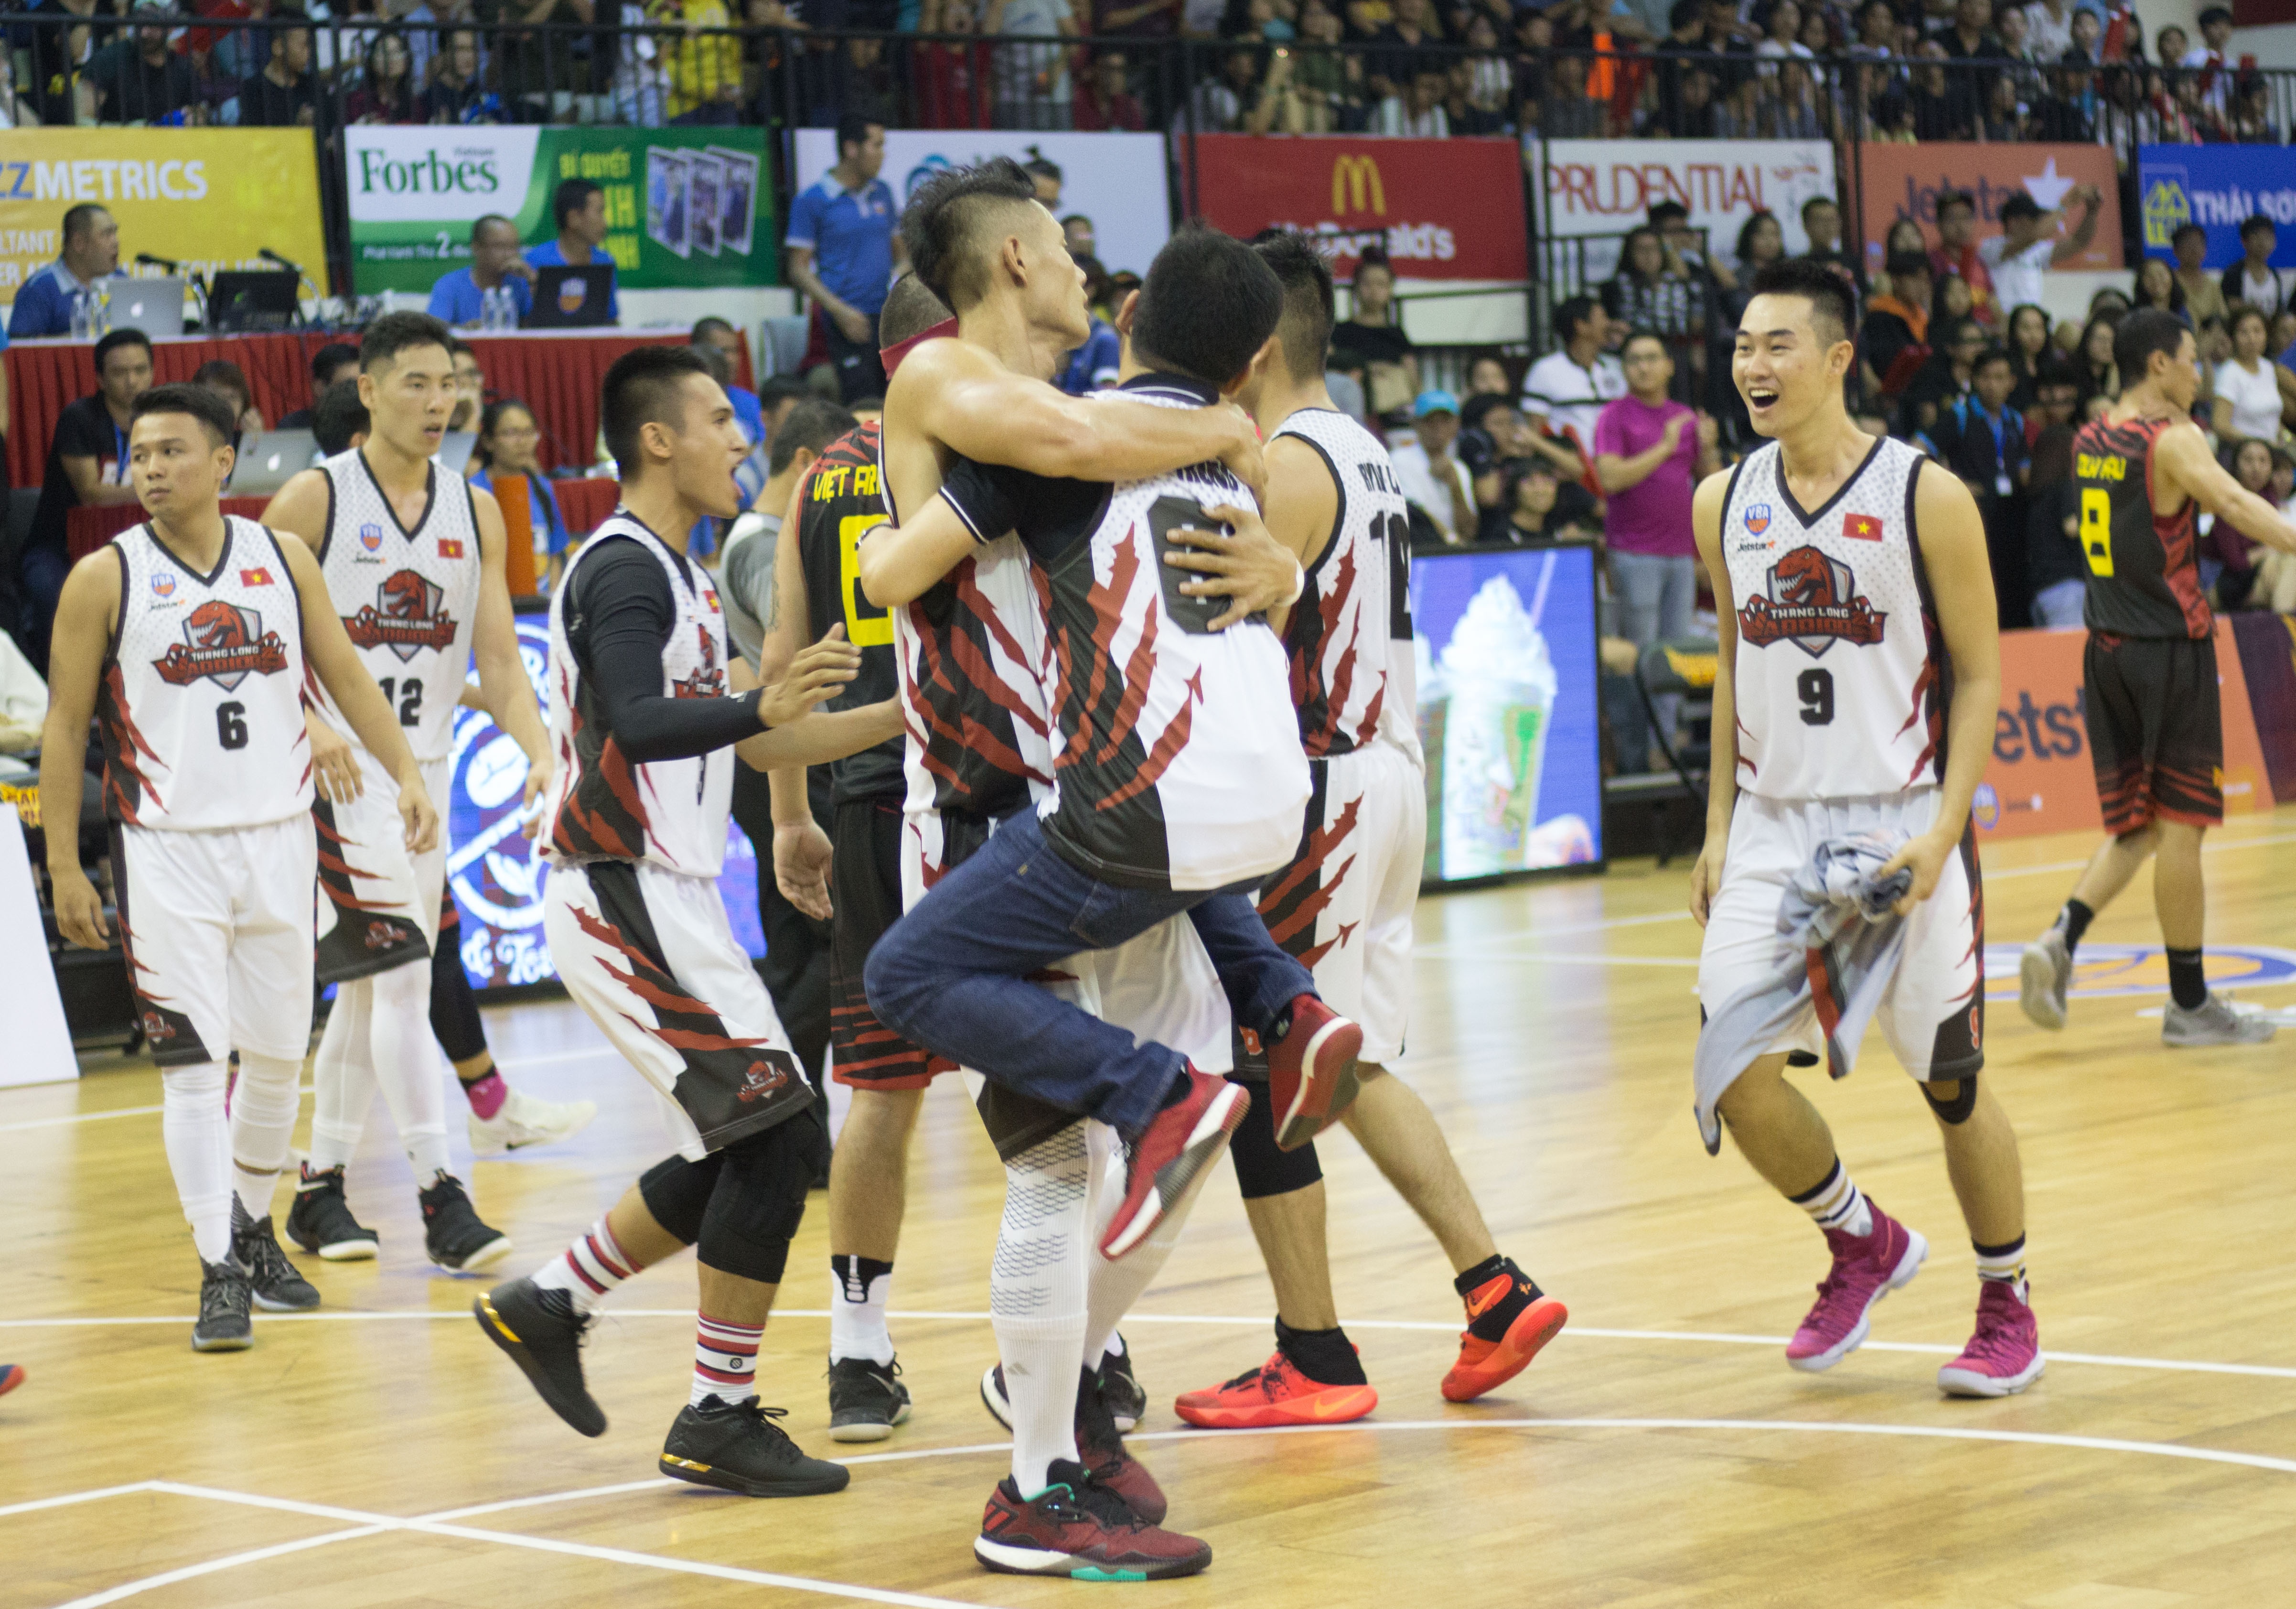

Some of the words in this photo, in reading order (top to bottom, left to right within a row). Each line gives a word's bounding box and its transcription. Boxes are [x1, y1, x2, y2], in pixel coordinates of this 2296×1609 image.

[358, 149, 498, 193] Forbes
[436, 232, 451, 258] 2
[814, 464, 851, 504] VIỆT
[1748, 505, 1769, 519] VBA
[2080, 487, 2114, 578] 8
[1770, 606, 1815, 620] THANG
[1818, 606, 1850, 619] LONG
[192, 649, 228, 662] THANG
[230, 645, 260, 658] LONG
[379, 677, 424, 727] 12
[1797, 668, 1835, 726] 9
[216, 700, 249, 751] 6
